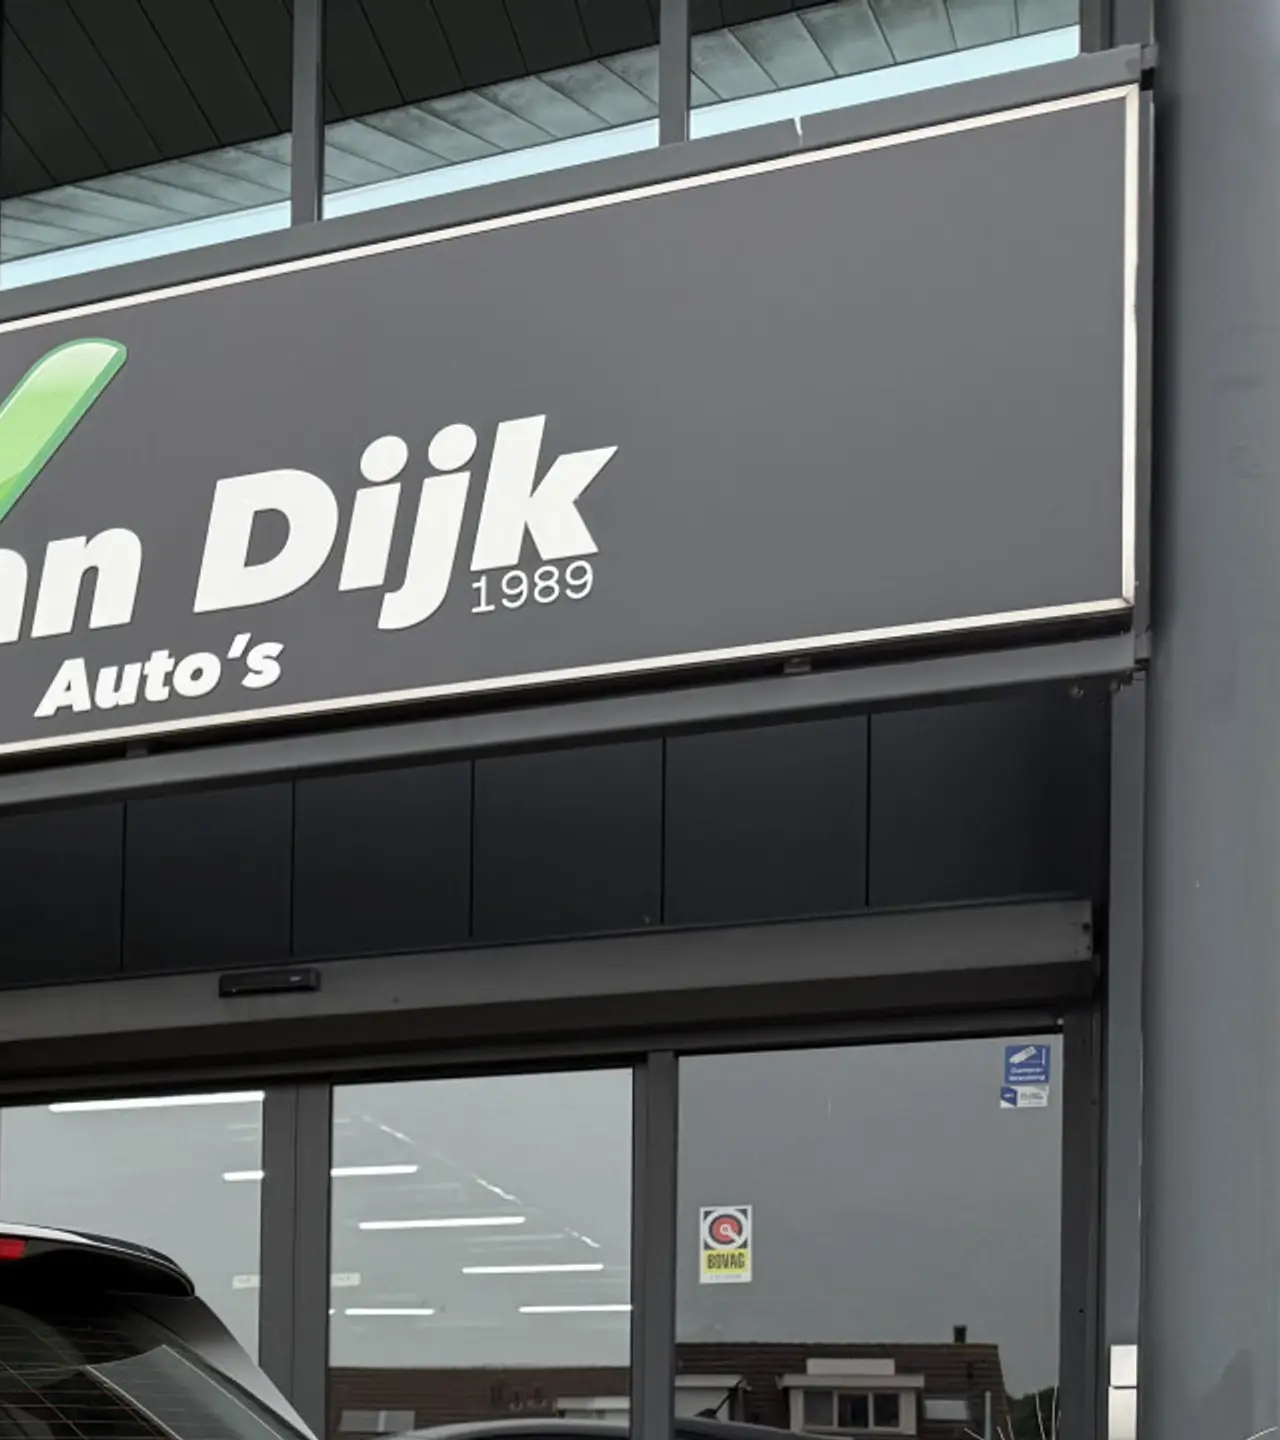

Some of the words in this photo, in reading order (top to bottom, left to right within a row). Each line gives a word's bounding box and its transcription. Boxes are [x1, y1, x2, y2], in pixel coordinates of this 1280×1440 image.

[193, 413, 620, 631] Dijk
[470, 559, 595, 614] 1989
[33, 632, 285, 718] Auto's
[706, 1250, 746, 1270] BOVAG
